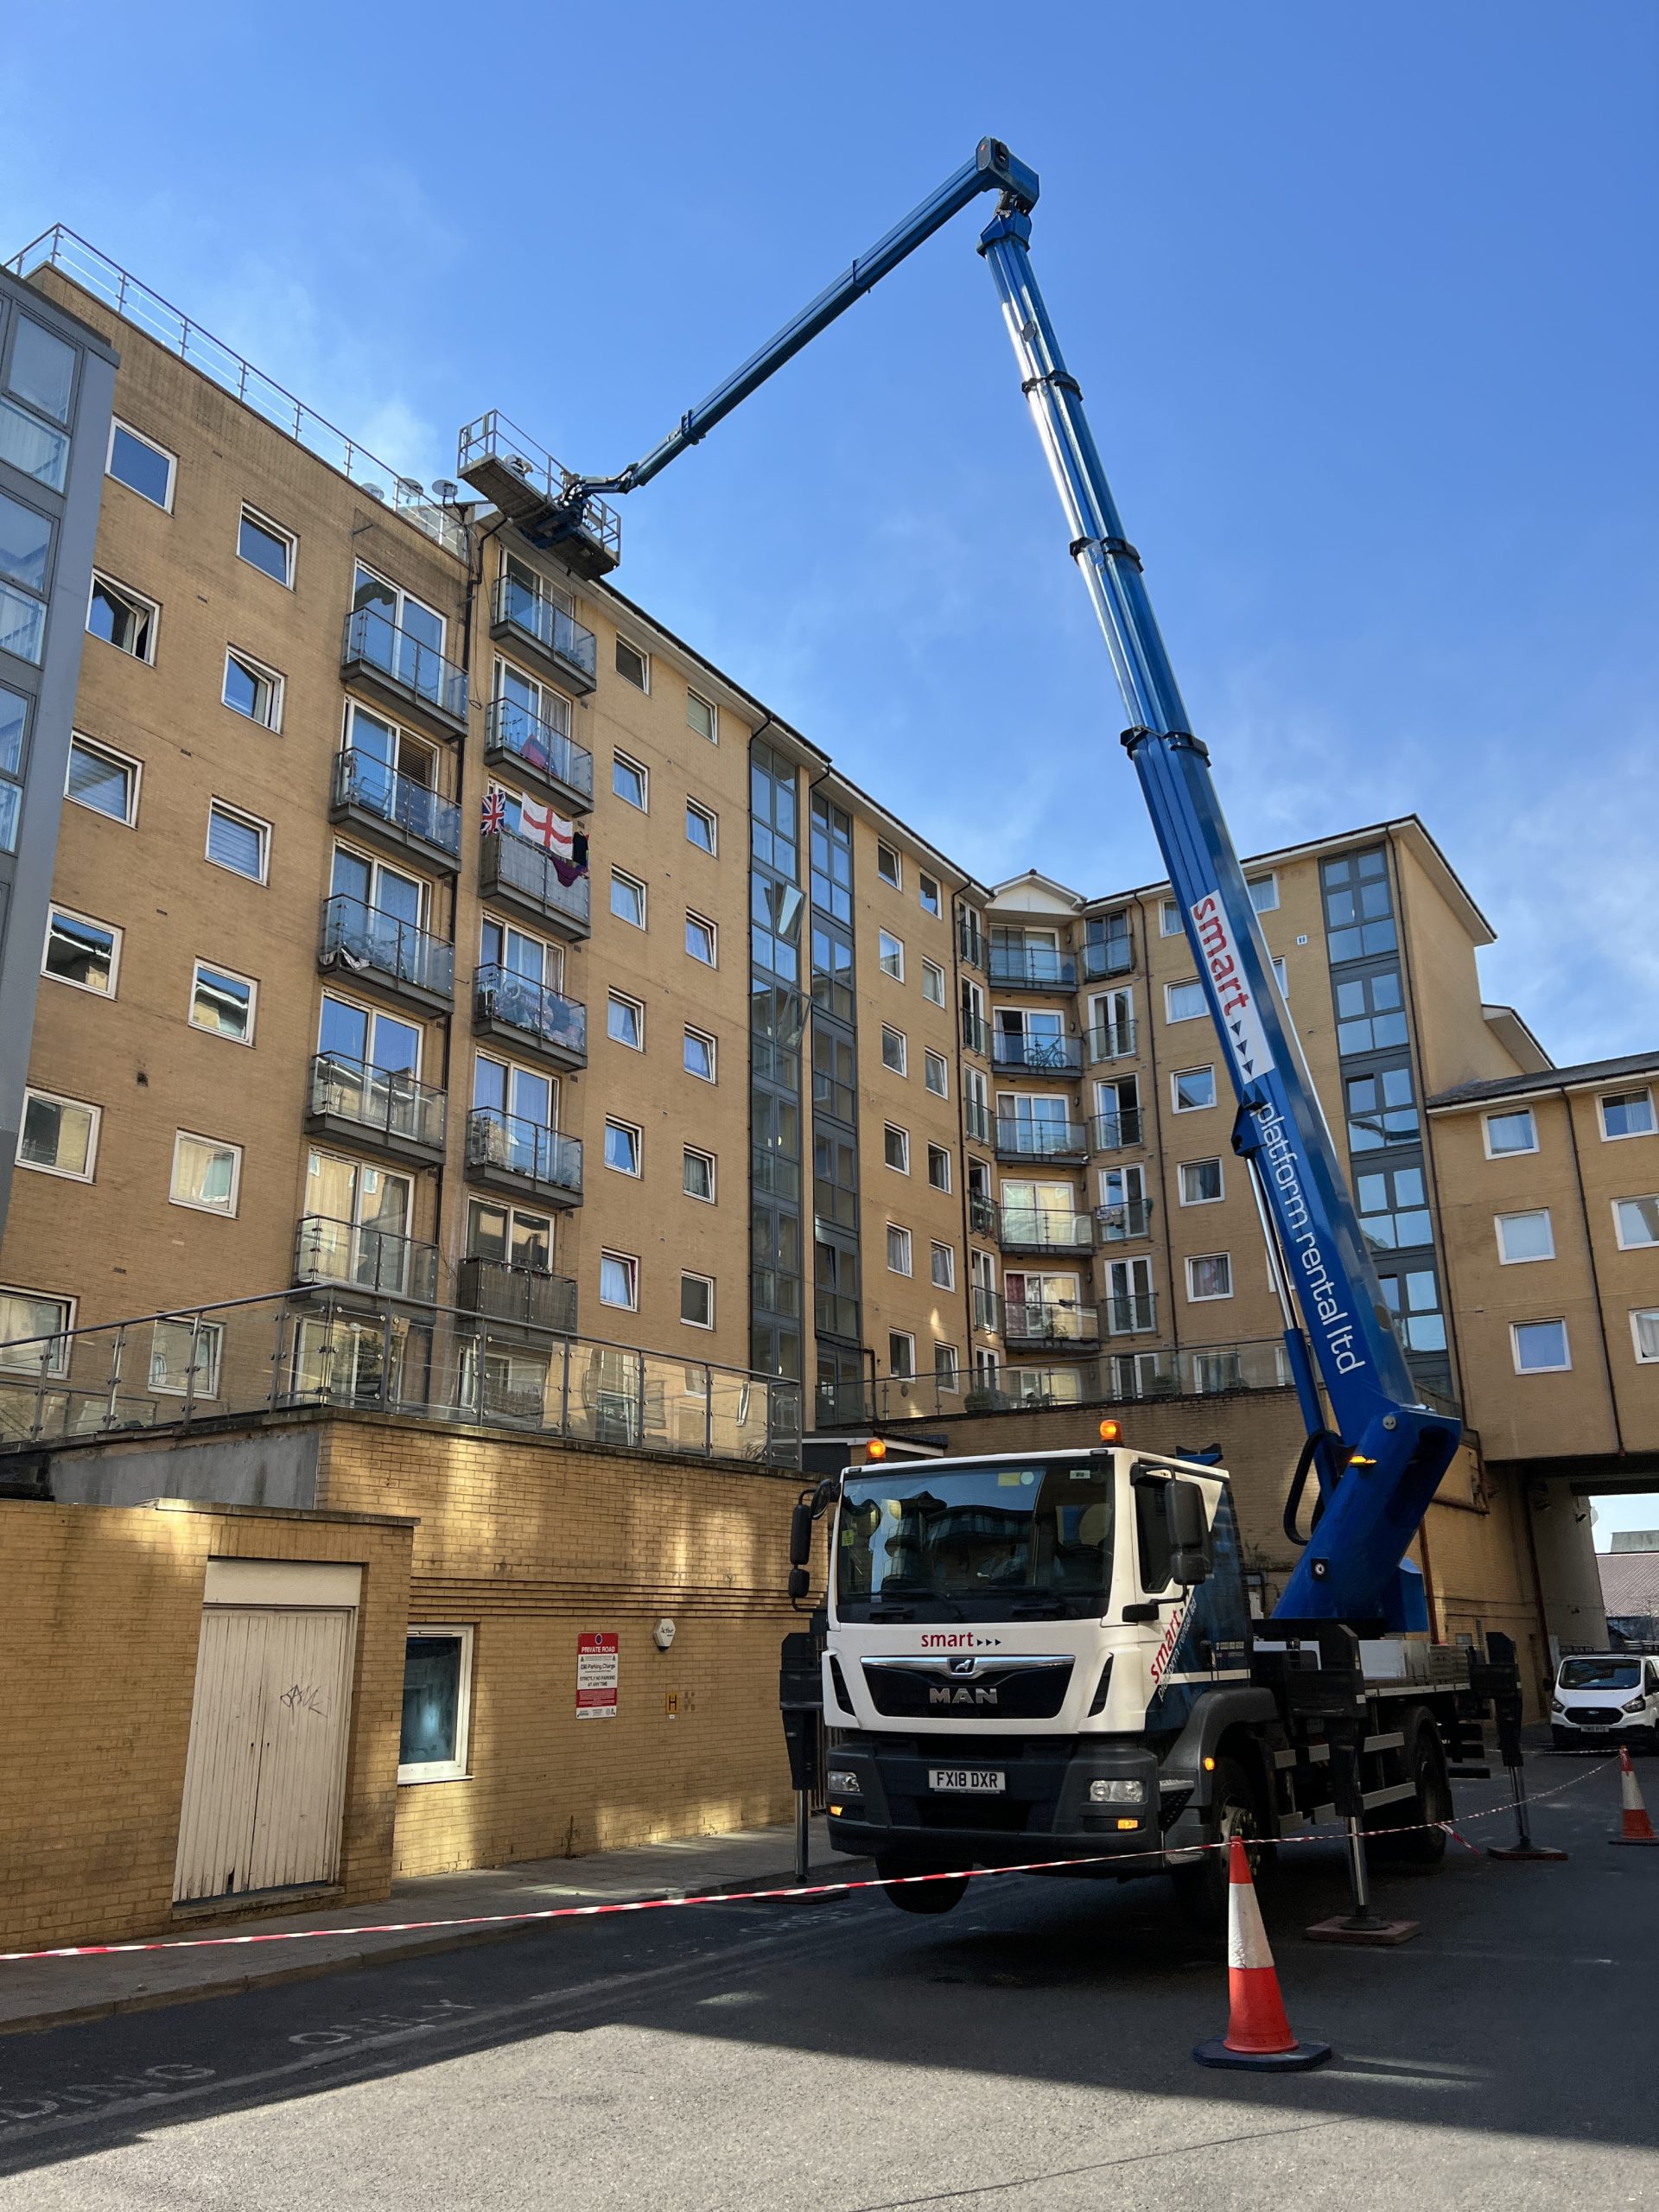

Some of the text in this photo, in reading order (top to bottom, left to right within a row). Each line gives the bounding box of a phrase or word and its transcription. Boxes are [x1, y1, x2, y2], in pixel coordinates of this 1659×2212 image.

[1193, 898, 1249, 1017] smart
[1249, 1102, 1366, 1375] platform rental ltd
[921, 1631, 974, 1648] smart
[1178, 1611, 1192, 1649] rental
[1150, 1609, 1181, 1684] smart
[668, 1694, 677, 1711] H
[929, 1688, 998, 1704] MAN
[937, 1771, 998, 1788] FX18 DXR
